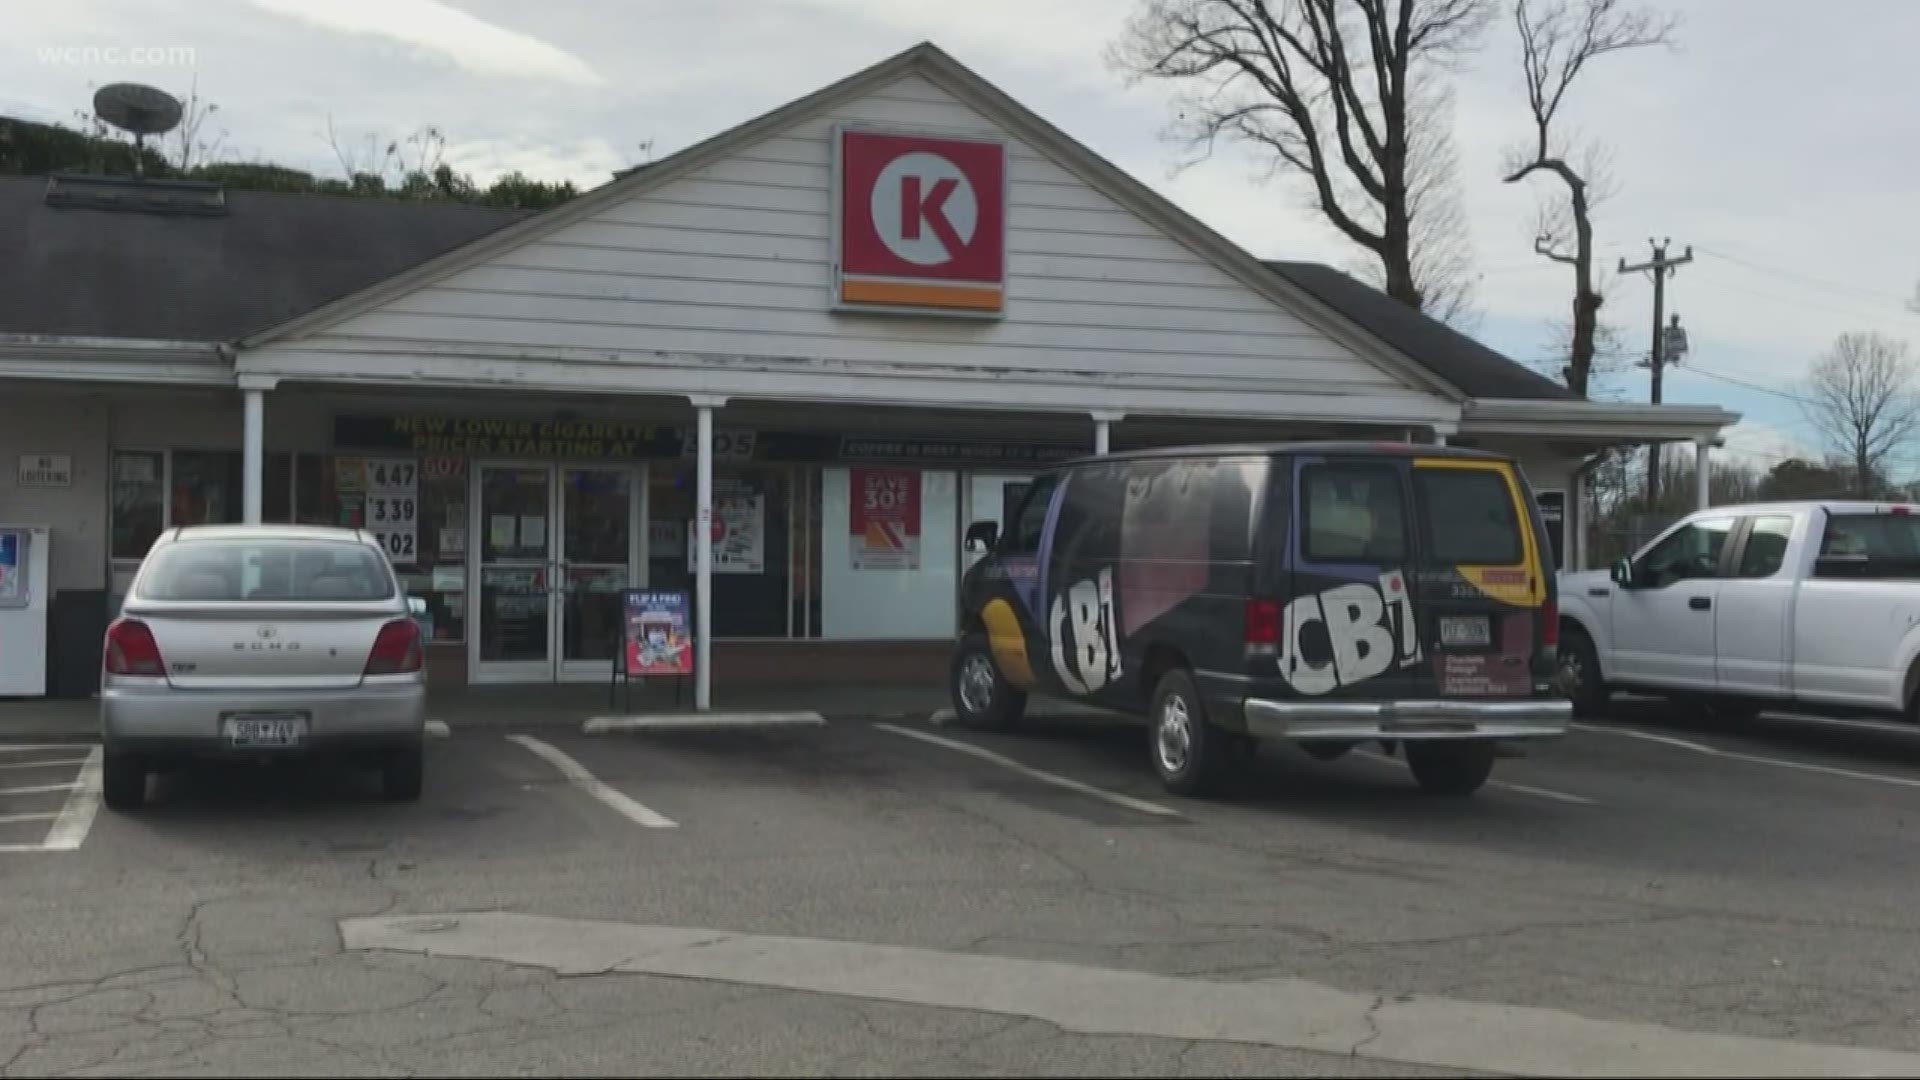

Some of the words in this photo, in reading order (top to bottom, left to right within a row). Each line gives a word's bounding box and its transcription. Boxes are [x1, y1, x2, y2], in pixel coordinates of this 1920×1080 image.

[901, 176, 963, 252] K
[393, 417, 447, 434] NEW
[455, 418, 534, 437] LOWER
[540, 421, 658, 440] CIGARETTE
[413, 435, 491, 454] PRICES
[498, 438, 603, 457] STARTING
[611, 441, 638, 457] AT
[21, 471, 69, 483] LOITERING
[865, 476, 910, 490] SAVE
